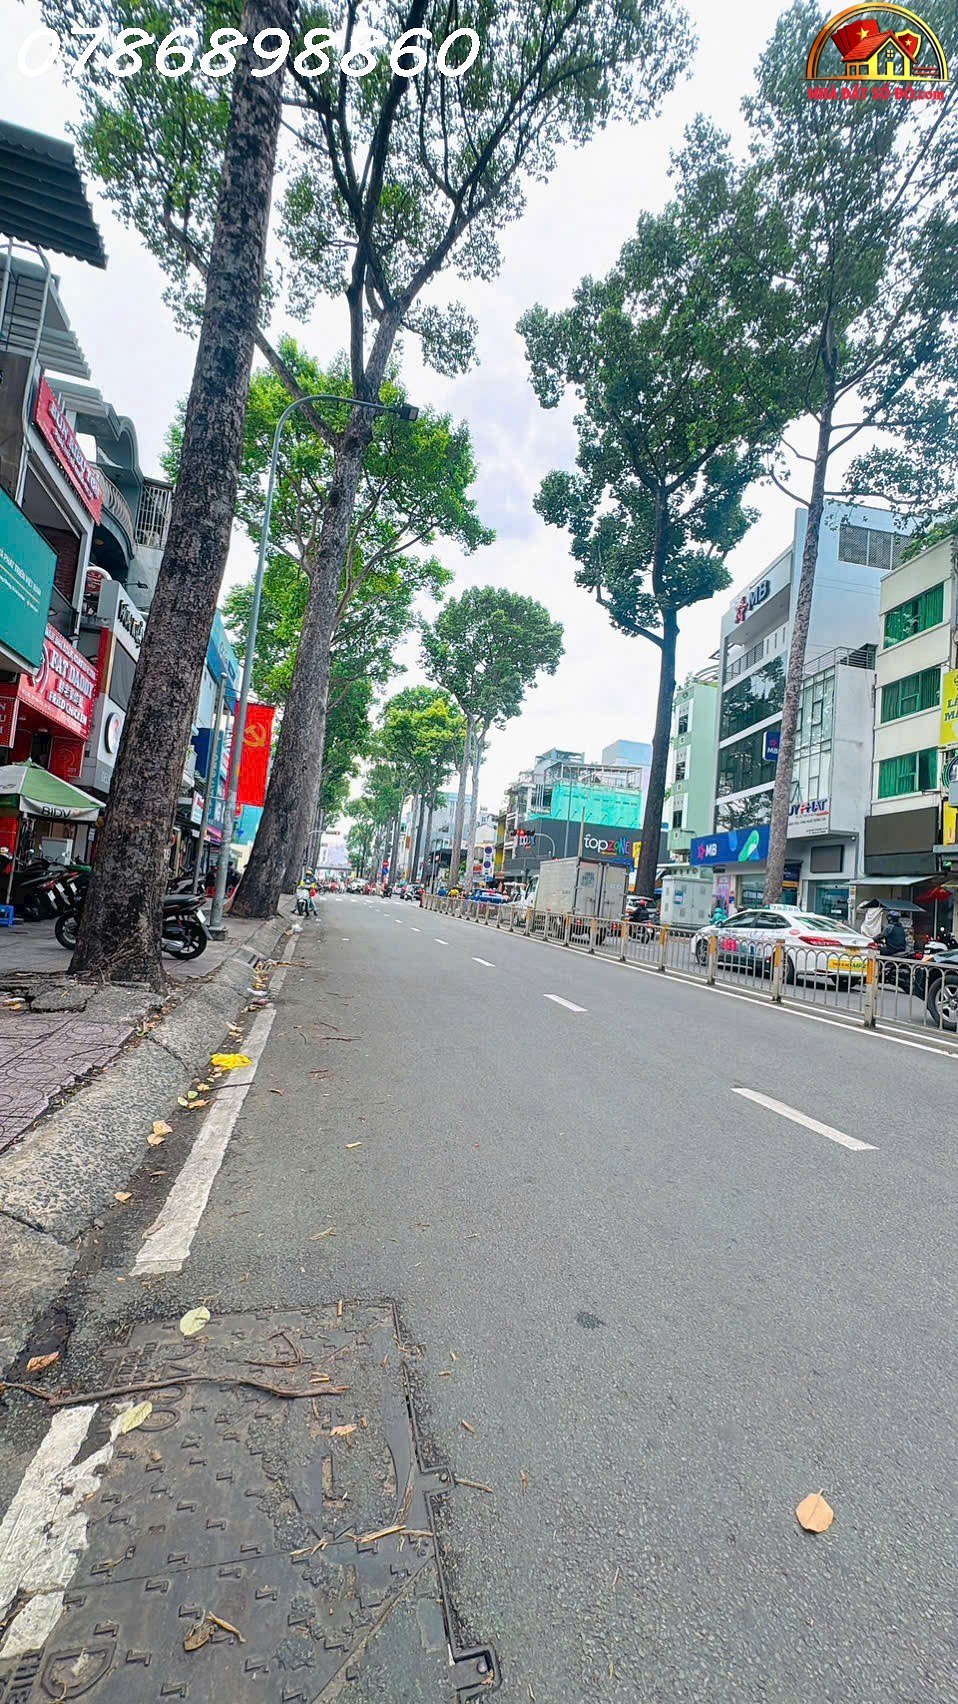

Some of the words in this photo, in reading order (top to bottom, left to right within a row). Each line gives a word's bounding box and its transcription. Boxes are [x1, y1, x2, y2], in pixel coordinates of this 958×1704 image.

[748, 580, 770, 611] MB
[41, 806, 72, 818] BIDV
[705, 843, 718, 857] MB
